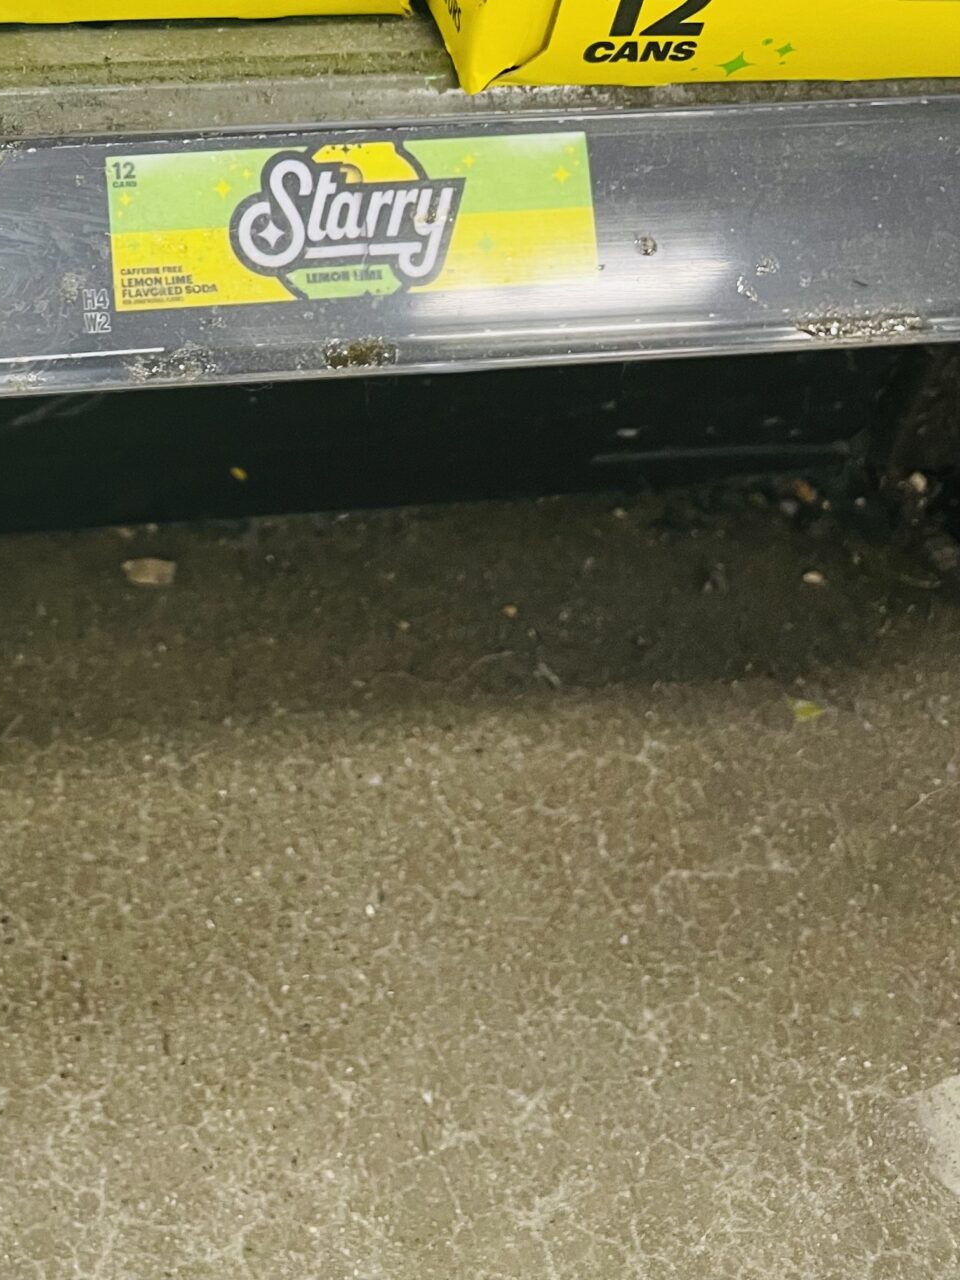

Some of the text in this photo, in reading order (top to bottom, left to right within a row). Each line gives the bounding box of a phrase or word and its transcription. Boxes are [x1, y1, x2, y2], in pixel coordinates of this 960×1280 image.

[583, 41, 698, 64] CANS
[112, 161, 136, 180] 12
[238, 159, 453, 277] Starry
[121, 275, 193, 287] LEMON LIME
